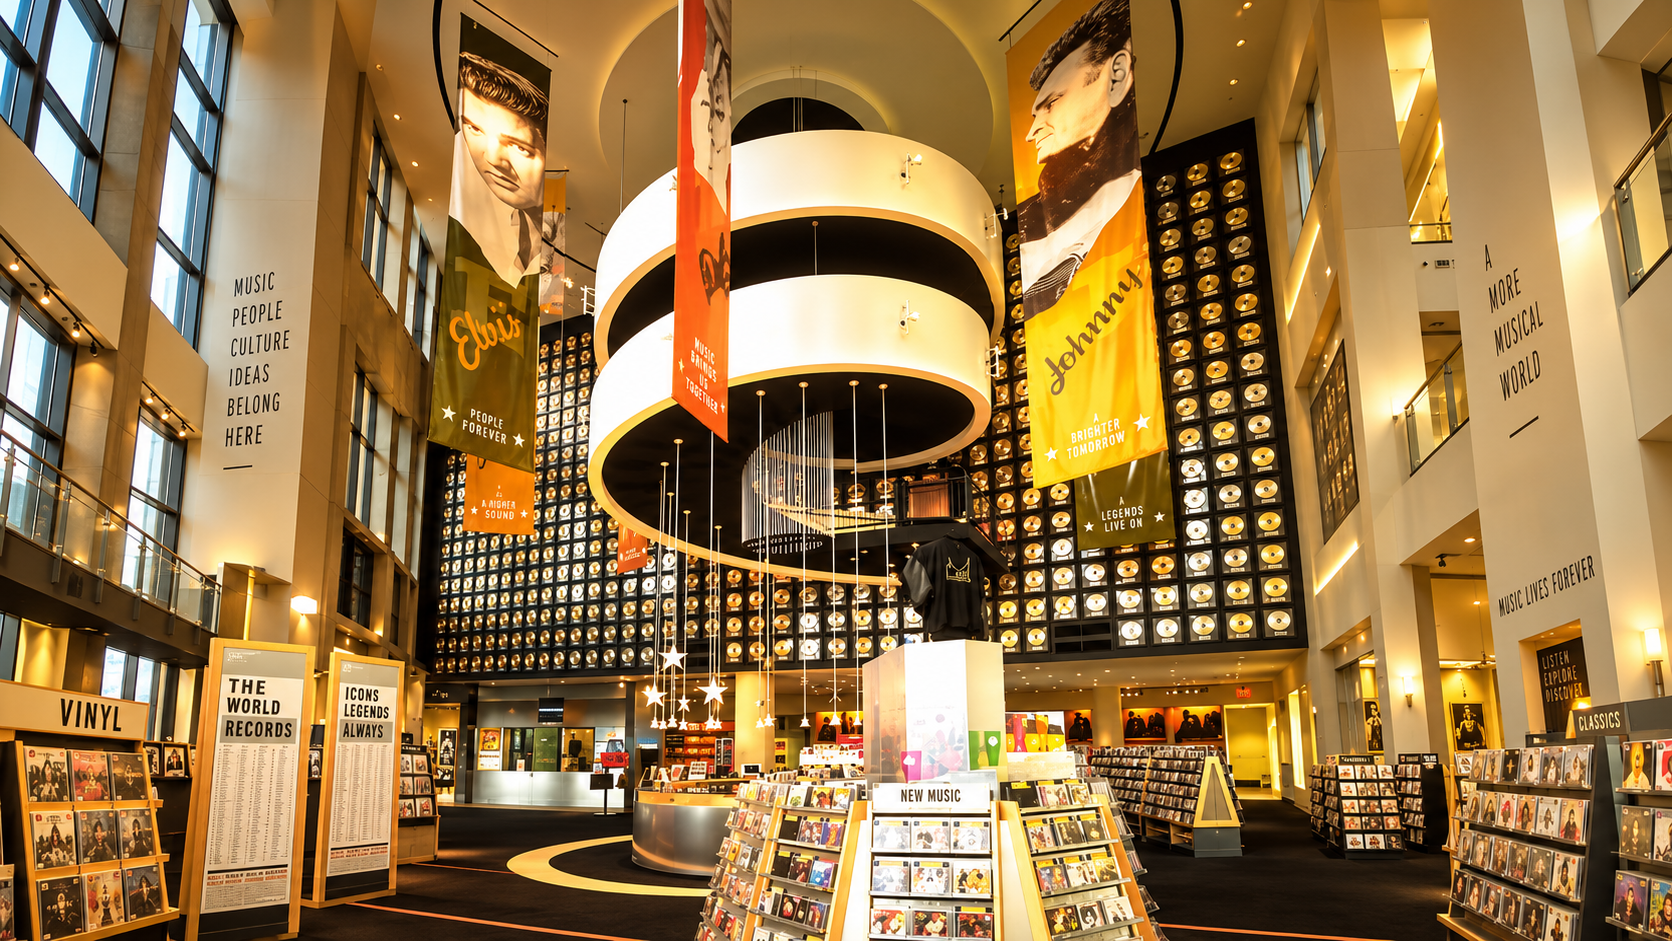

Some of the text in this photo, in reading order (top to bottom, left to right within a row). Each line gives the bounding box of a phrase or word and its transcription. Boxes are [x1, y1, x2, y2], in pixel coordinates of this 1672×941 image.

[1485, 244, 1492, 271] A
[233, 271, 275, 297] MUSIC
[1488, 267, 1521, 313] MORE
[232, 300, 282, 327] PEOPLE
[449, 301, 521, 371] Elvis
[1045, 268, 1143, 395] Johnny
[1494, 301, 1543, 357] MUSICAL
[230, 329, 290, 357] CULTURE
[694, 337, 716, 365] MUSIC
[229, 363, 270, 387] IDEAS
[699, 373, 708, 390] US
[1499, 350, 1541, 401] WORLD
[227, 392, 280, 417] BELONG
[685, 376, 718, 414] TOGETHER
[470, 408, 503, 429] PEOPLE
[1093, 412, 1099, 424] A
[225, 424, 263, 447] HERE
[462, 419, 507, 445] FOREVER
[1071, 418, 1120, 444] BRIGHTER
[1066, 430, 1125, 460] TOMORROW
[1101, 505, 1144, 521] LEGENDS
[1119, 496, 1125, 506] A
[485, 509, 515, 520] SOUND
[1104, 517, 1143, 533] LIVE ON
[1498, 555, 1595, 617] MUSIC LIVES FOREVER
[229, 678, 266, 695] THE
[345, 686, 379, 702] ICONS
[60, 698, 122, 732] VINYL
[227, 697, 281, 716] WORLD
[344, 703, 389, 719] LEGENDS
[225, 720, 292, 738] RECORDS
[343, 722, 384, 739] ALWAYS
[1578, 711, 1621, 731] CLASSICS
[900, 788, 961, 803] NEW MUSIC
